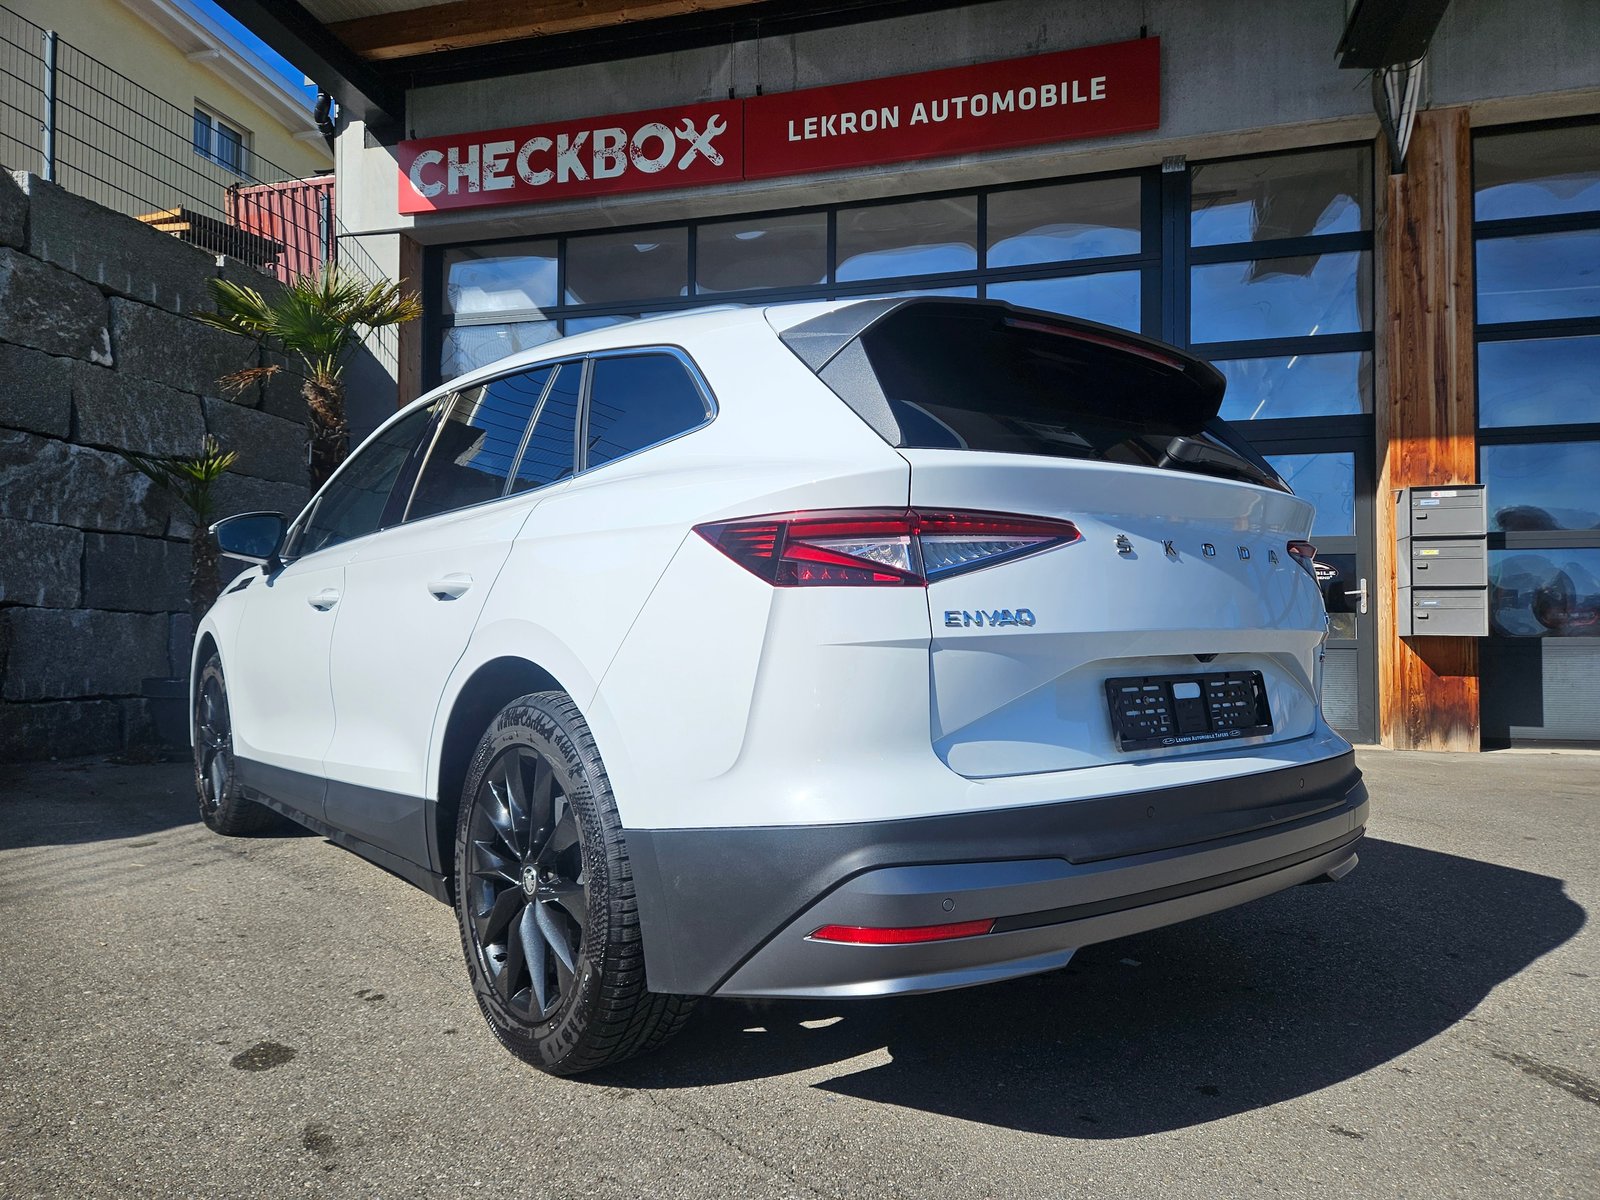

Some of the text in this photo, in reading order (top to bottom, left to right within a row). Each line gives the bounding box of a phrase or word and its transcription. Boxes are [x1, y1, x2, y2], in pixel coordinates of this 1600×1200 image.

[788, 76, 1107, 142] LEKRON AUTOMOBILE
[409, 114, 727, 198] CHECKBOX
[944, 608, 1037, 628] ENYAQ
